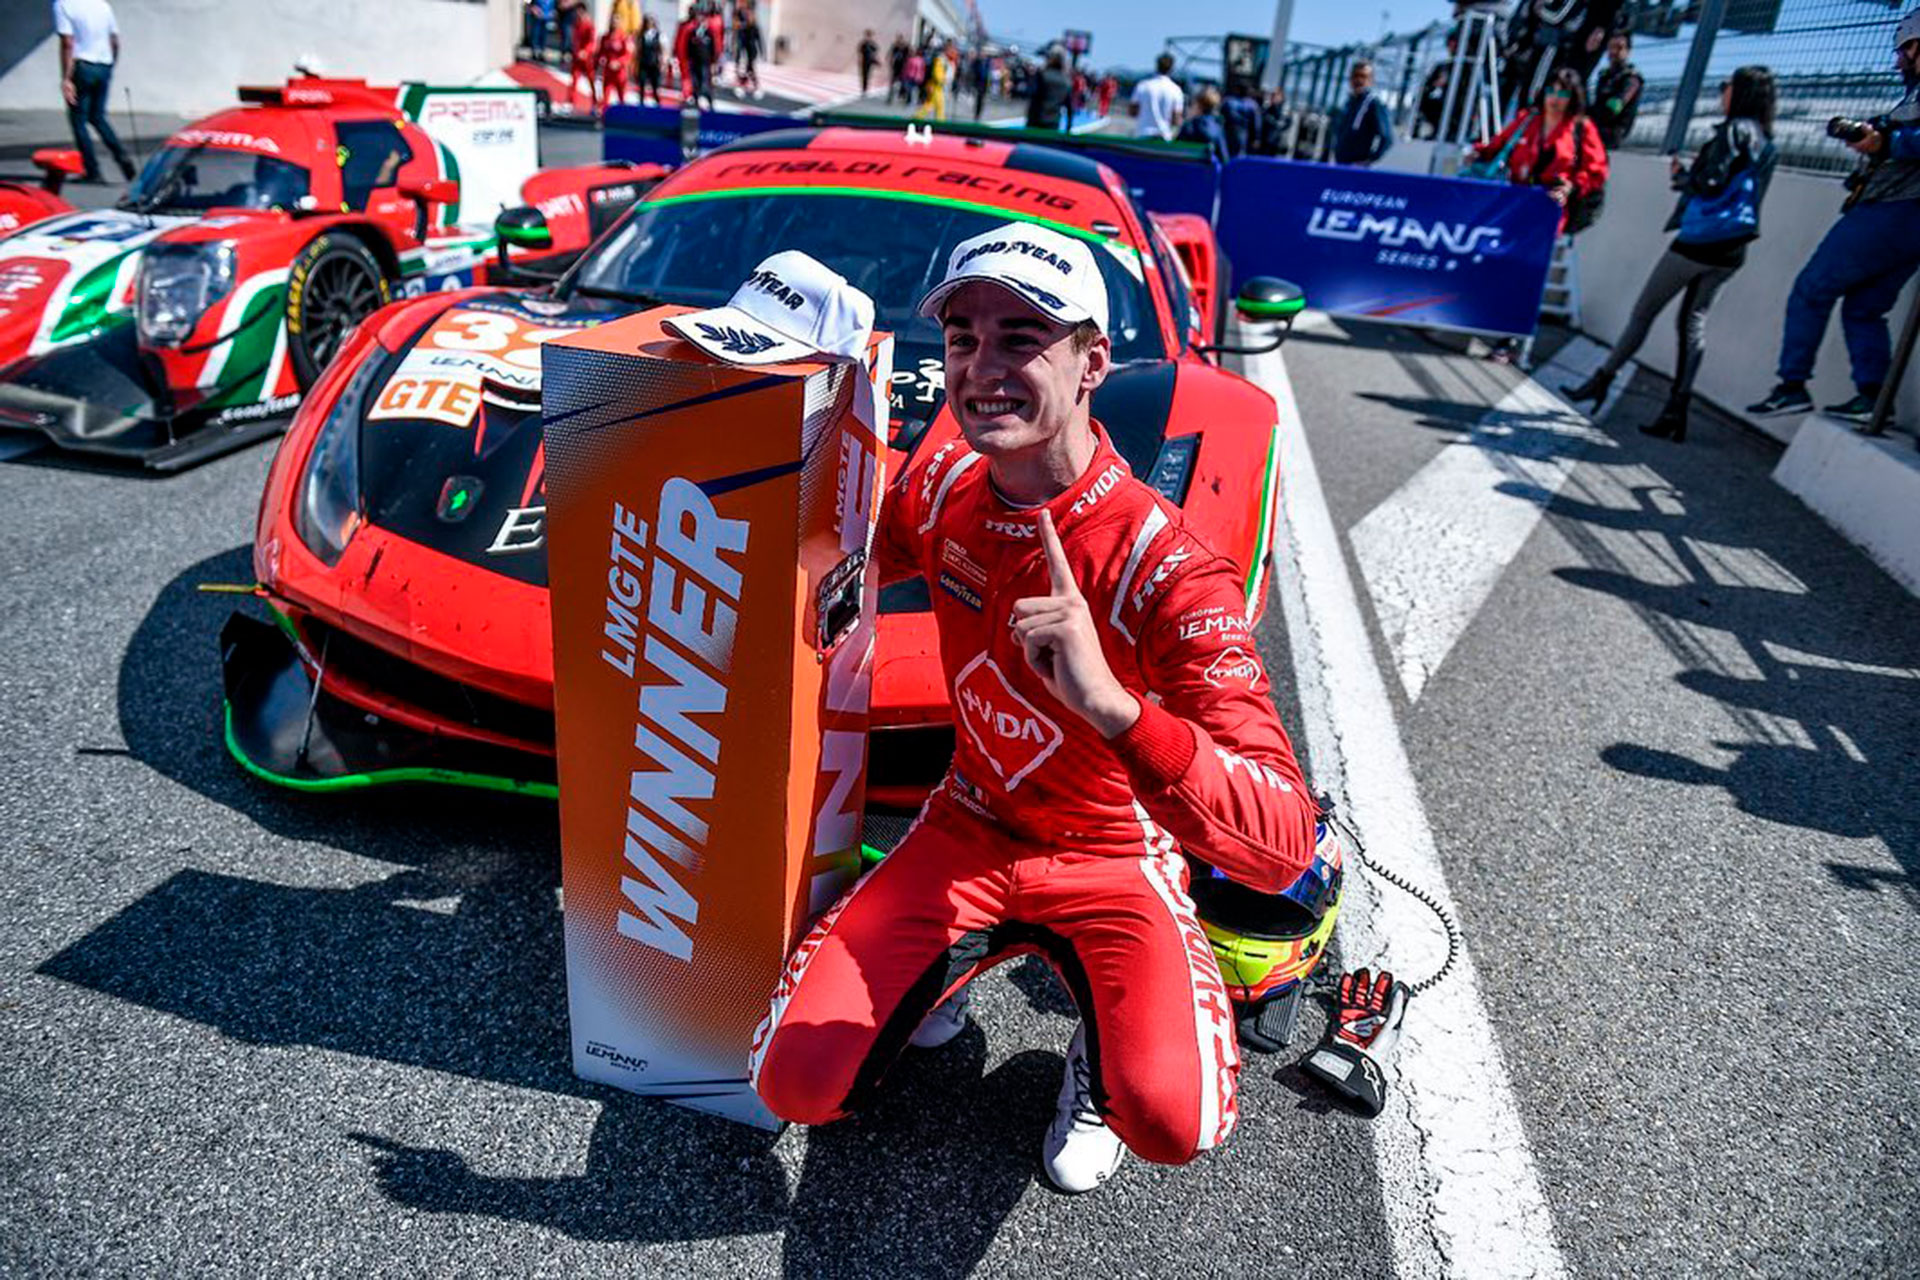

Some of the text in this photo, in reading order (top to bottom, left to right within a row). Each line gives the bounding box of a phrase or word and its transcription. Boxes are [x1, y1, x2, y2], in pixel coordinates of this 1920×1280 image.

[428, 100, 526, 122] PREMA
[1320, 188, 1408, 209] EUROPEAN
[1376, 249, 1439, 269] SERIES
[379, 378, 482, 417] GTE
[834, 429, 850, 534] LMGTE
[602, 502, 649, 679] LMGTE
[617, 476, 750, 963] WINNER
